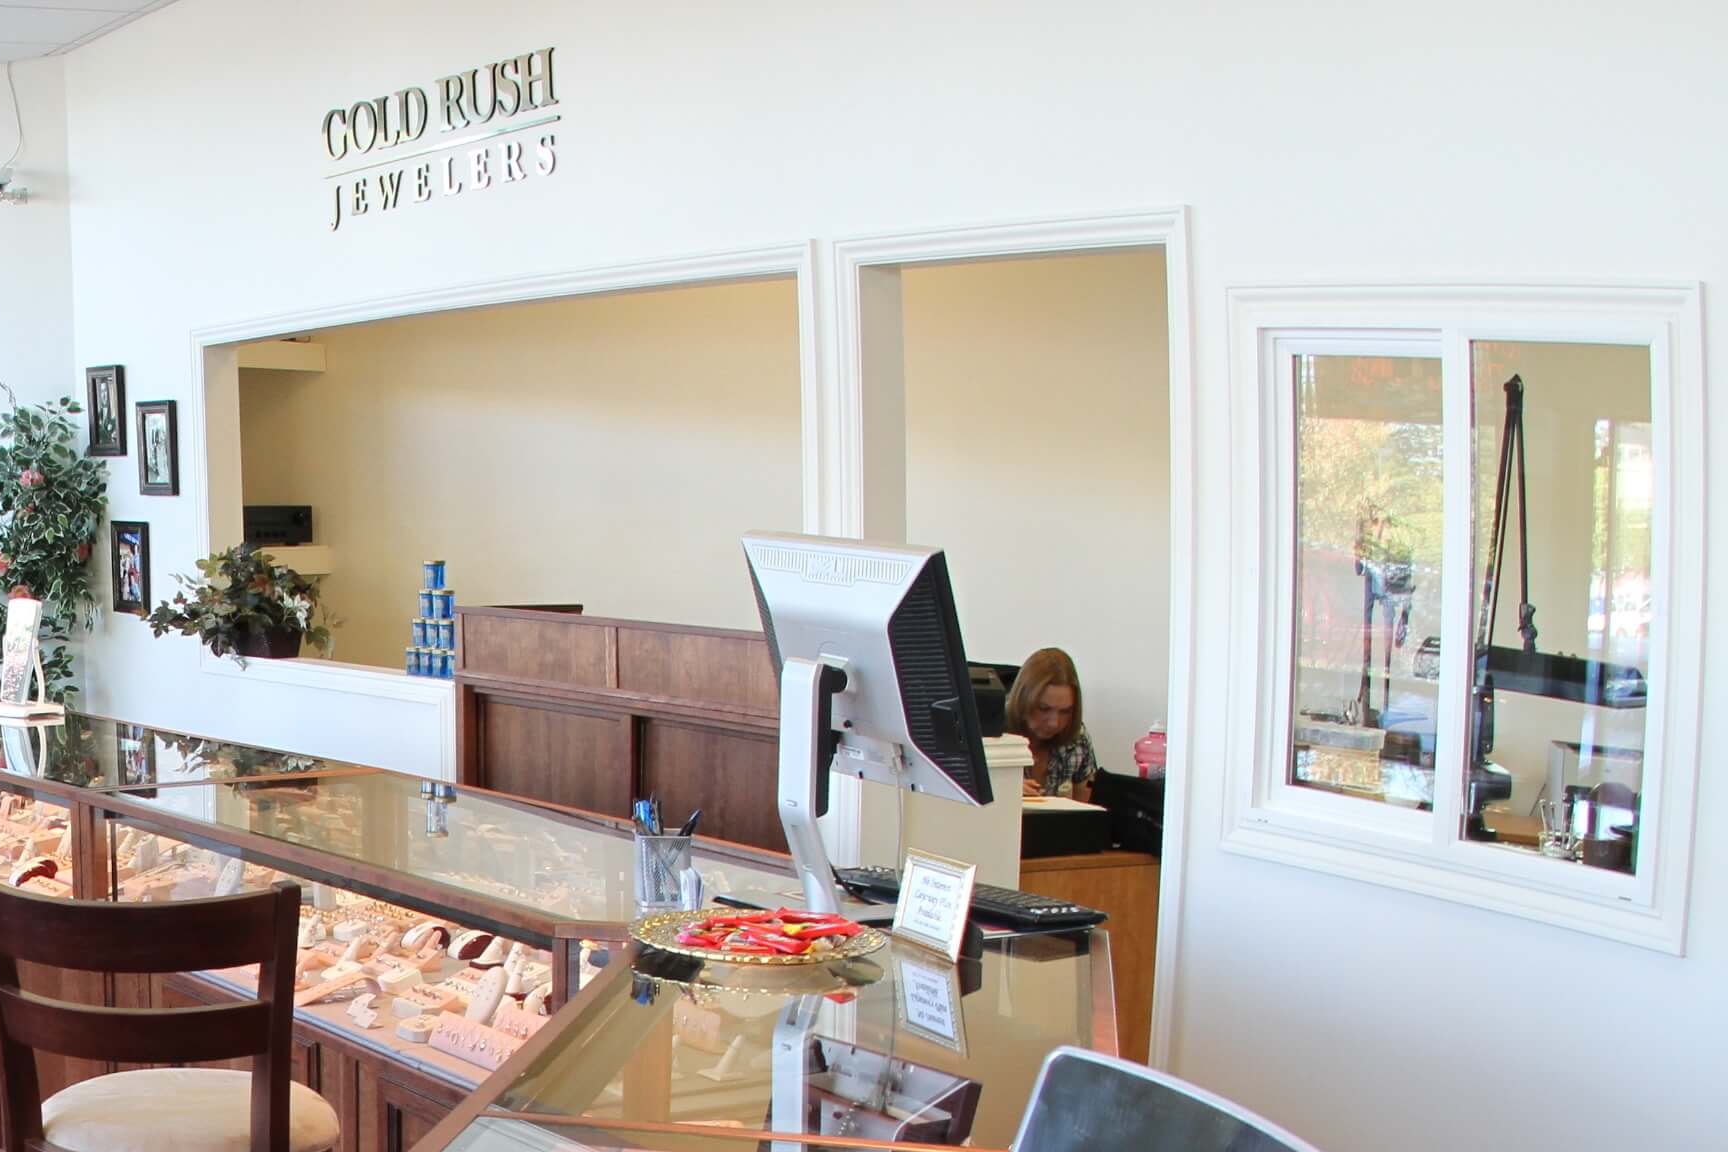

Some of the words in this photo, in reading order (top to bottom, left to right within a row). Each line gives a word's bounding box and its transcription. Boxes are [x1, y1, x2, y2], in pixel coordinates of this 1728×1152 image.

[321, 87, 429, 161] GOLD
[434, 46, 560, 133] RUSH
[329, 134, 557, 232] JEWELERS
